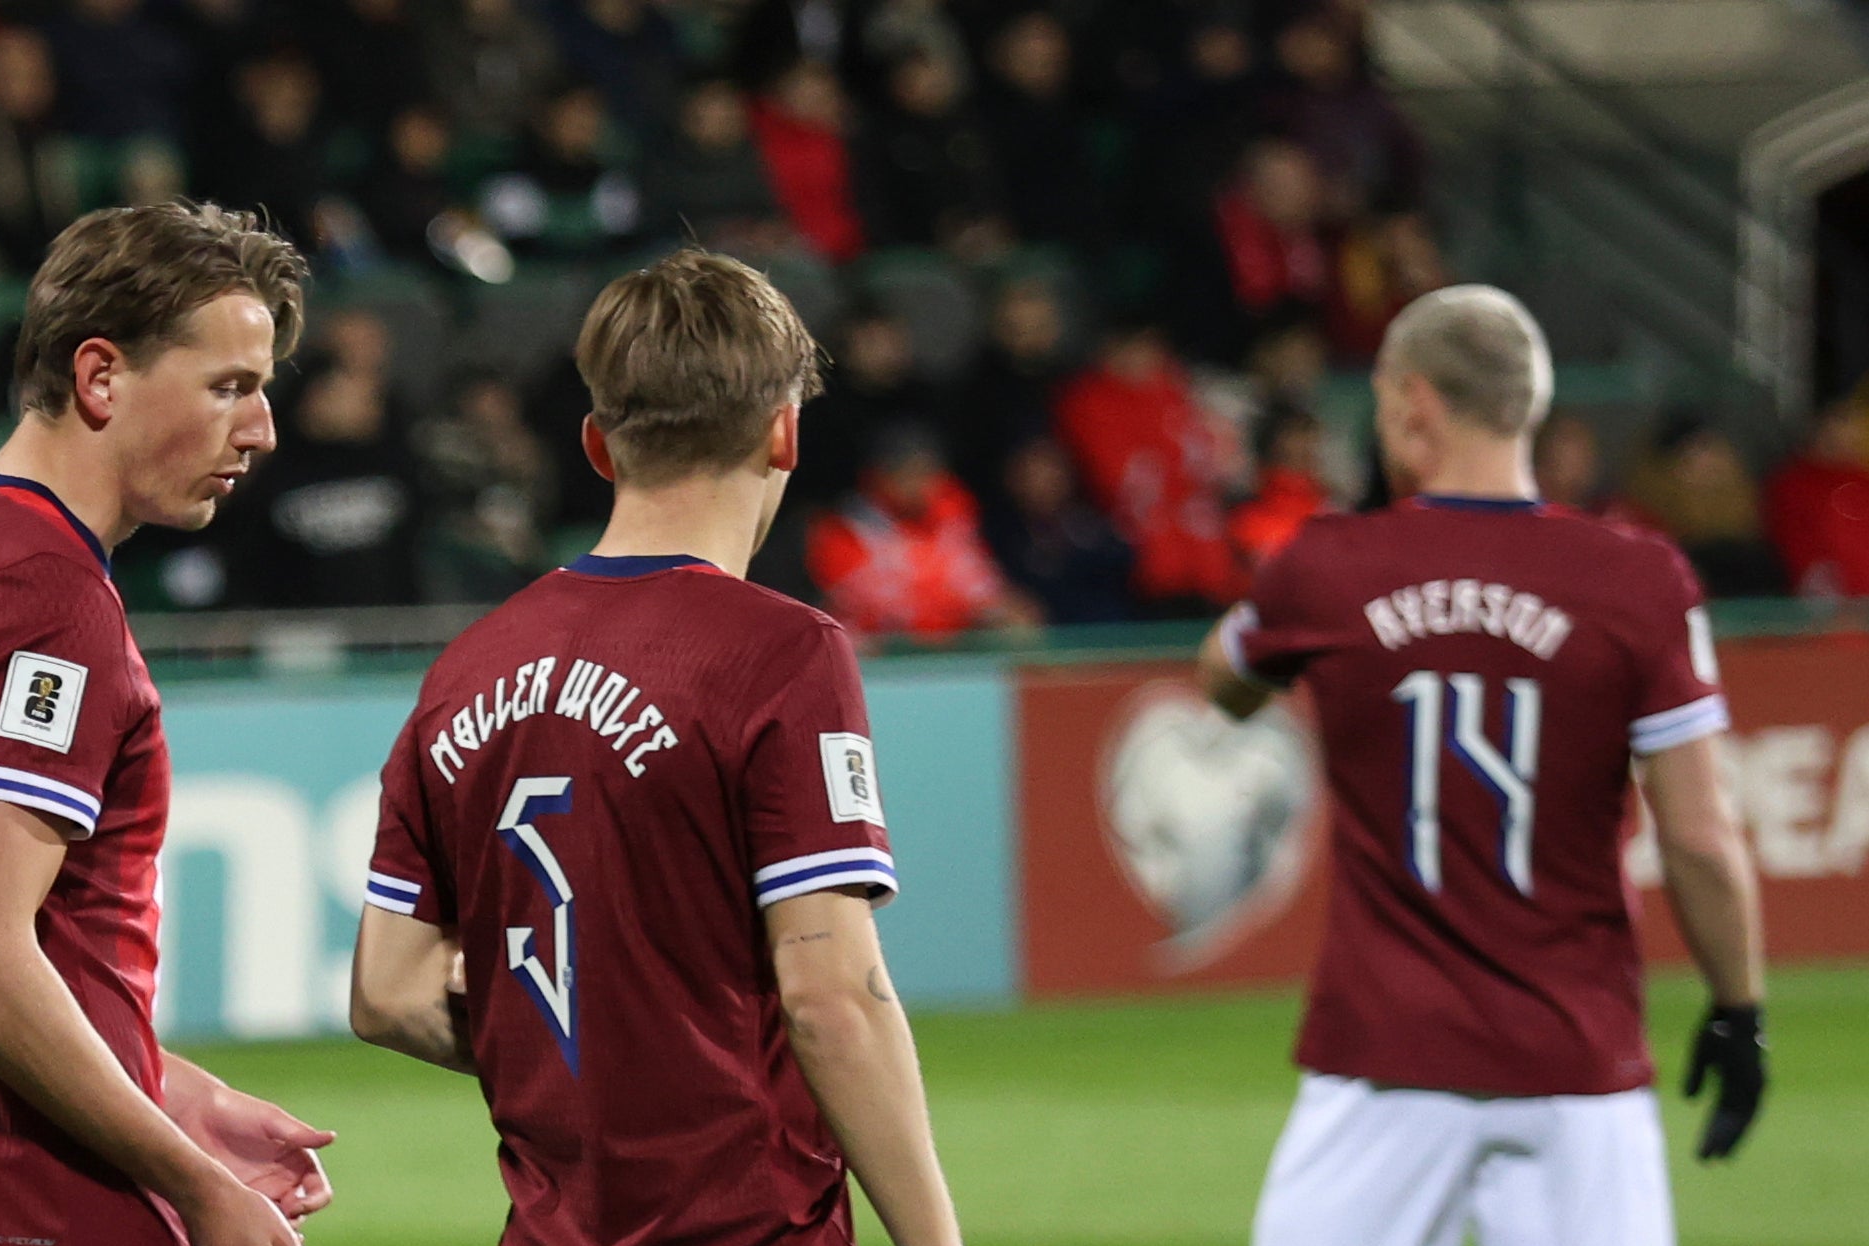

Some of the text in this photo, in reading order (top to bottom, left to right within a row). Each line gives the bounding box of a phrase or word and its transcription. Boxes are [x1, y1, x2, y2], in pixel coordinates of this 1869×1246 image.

[554, 658, 679, 778] WOLFE
[1389, 669, 1543, 898] 14
[495, 776, 579, 1080] 5
